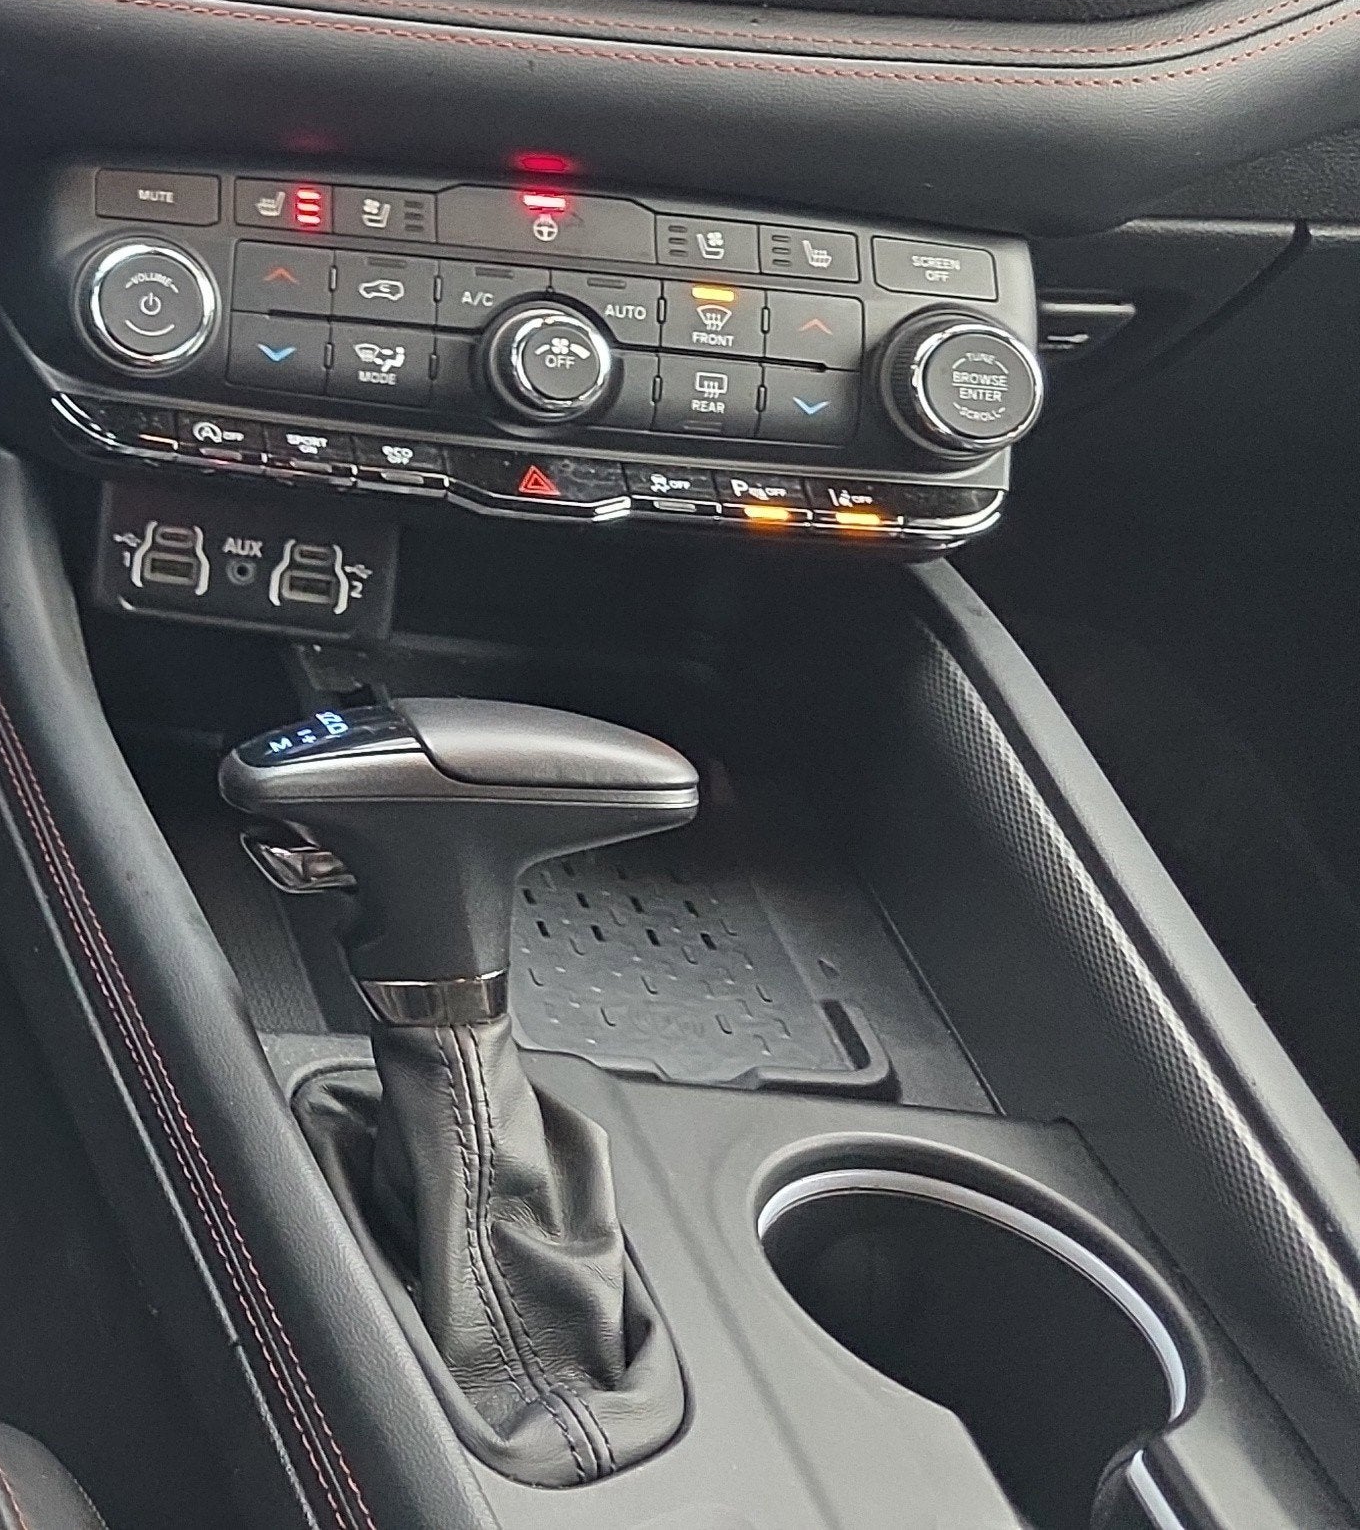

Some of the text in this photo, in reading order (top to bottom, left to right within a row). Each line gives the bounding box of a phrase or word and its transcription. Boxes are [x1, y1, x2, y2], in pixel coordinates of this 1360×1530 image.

[138, 189, 175, 204] MUTE
[911, 255, 961, 270] SCREEN
[130, 273, 172, 287] VOLUME
[925, 271, 949, 282] OFF
[461, 291, 494, 307] A/C
[604, 304, 647, 320] AUTO
[692, 332, 734, 347] FRONT
[545, 355, 575, 369] OFF
[966, 352, 996, 365] TUNE
[359, 371, 396, 385] MODE
[952, 371, 1008, 387] BROWSE
[959, 388, 1002, 402] ENTER
[691, 399, 725, 414] REAR
[286, 433, 328, 447] SPORT
[669, 479, 691, 490] OFF
[222, 537, 263, 558] AUX
[351, 581, 364, 599] 2
[269, 737, 293, 752] M
